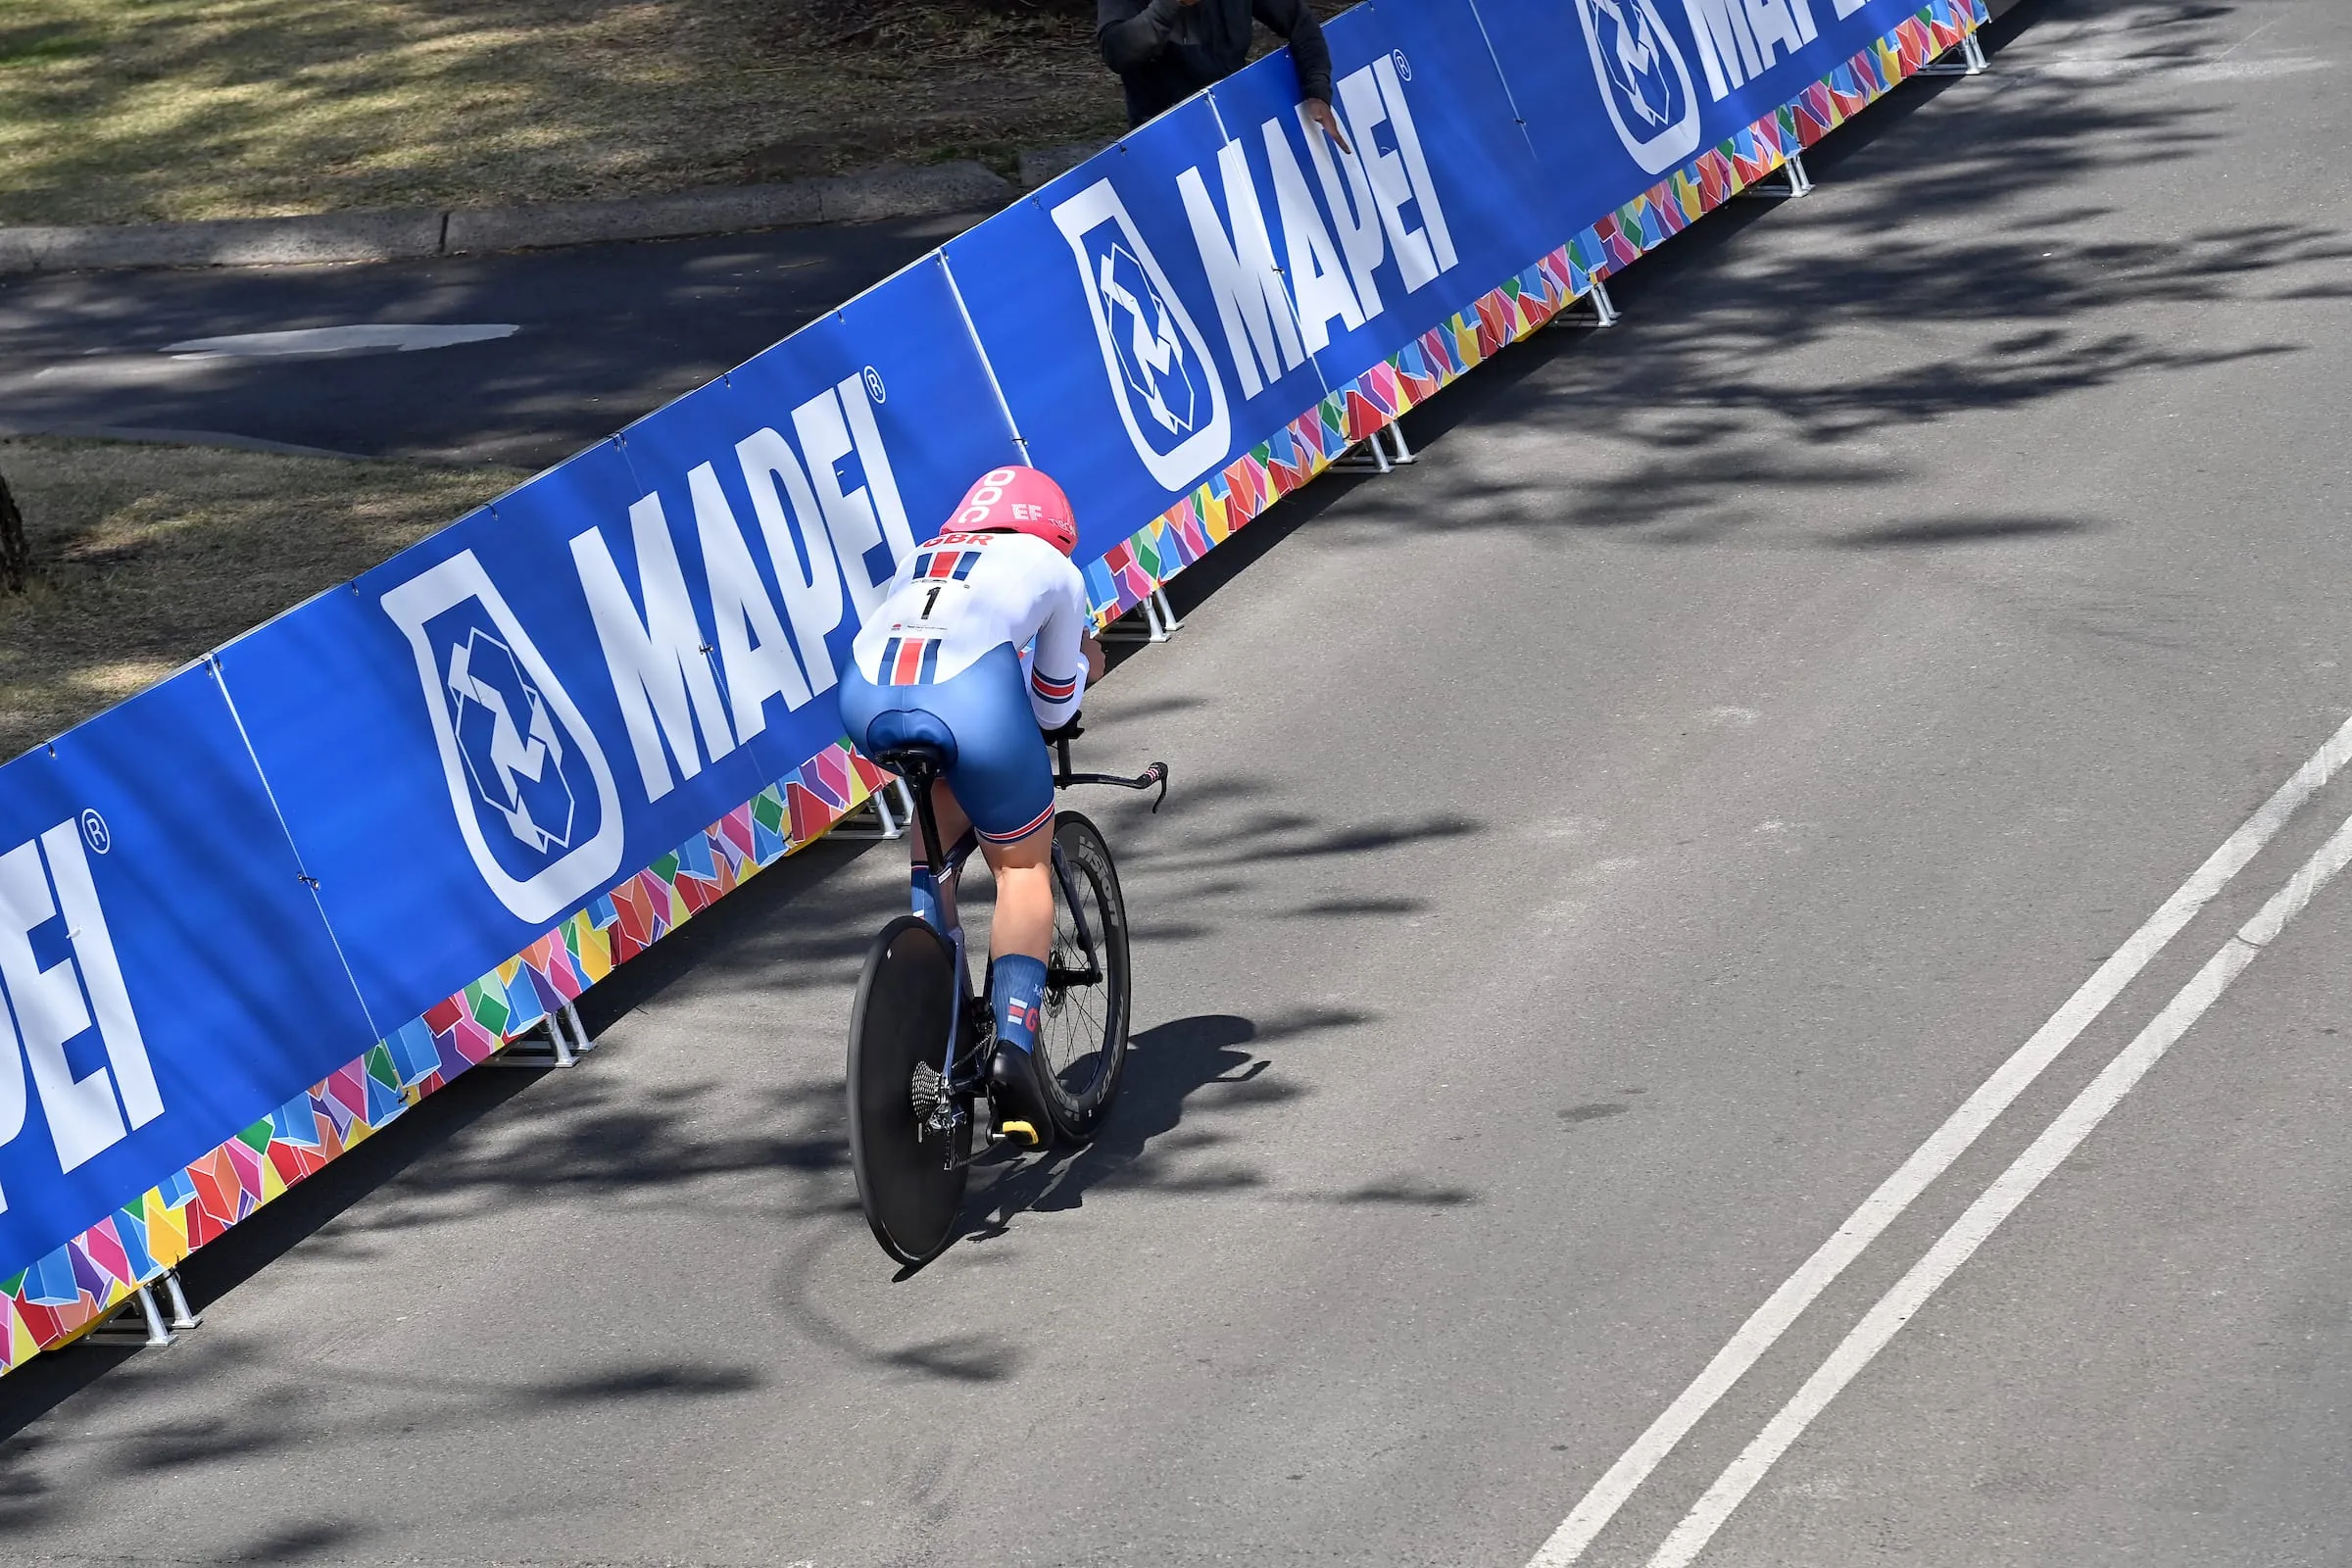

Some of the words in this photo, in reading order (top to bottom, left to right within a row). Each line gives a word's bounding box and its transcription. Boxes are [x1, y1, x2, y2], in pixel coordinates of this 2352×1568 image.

[1176, 53, 1459, 401] MAPEI
[1011, 503, 1043, 521] EF
[923, 534, 994, 548] GBR
[568, 371, 917, 804] MAPEI
[921, 586, 942, 620] 1
